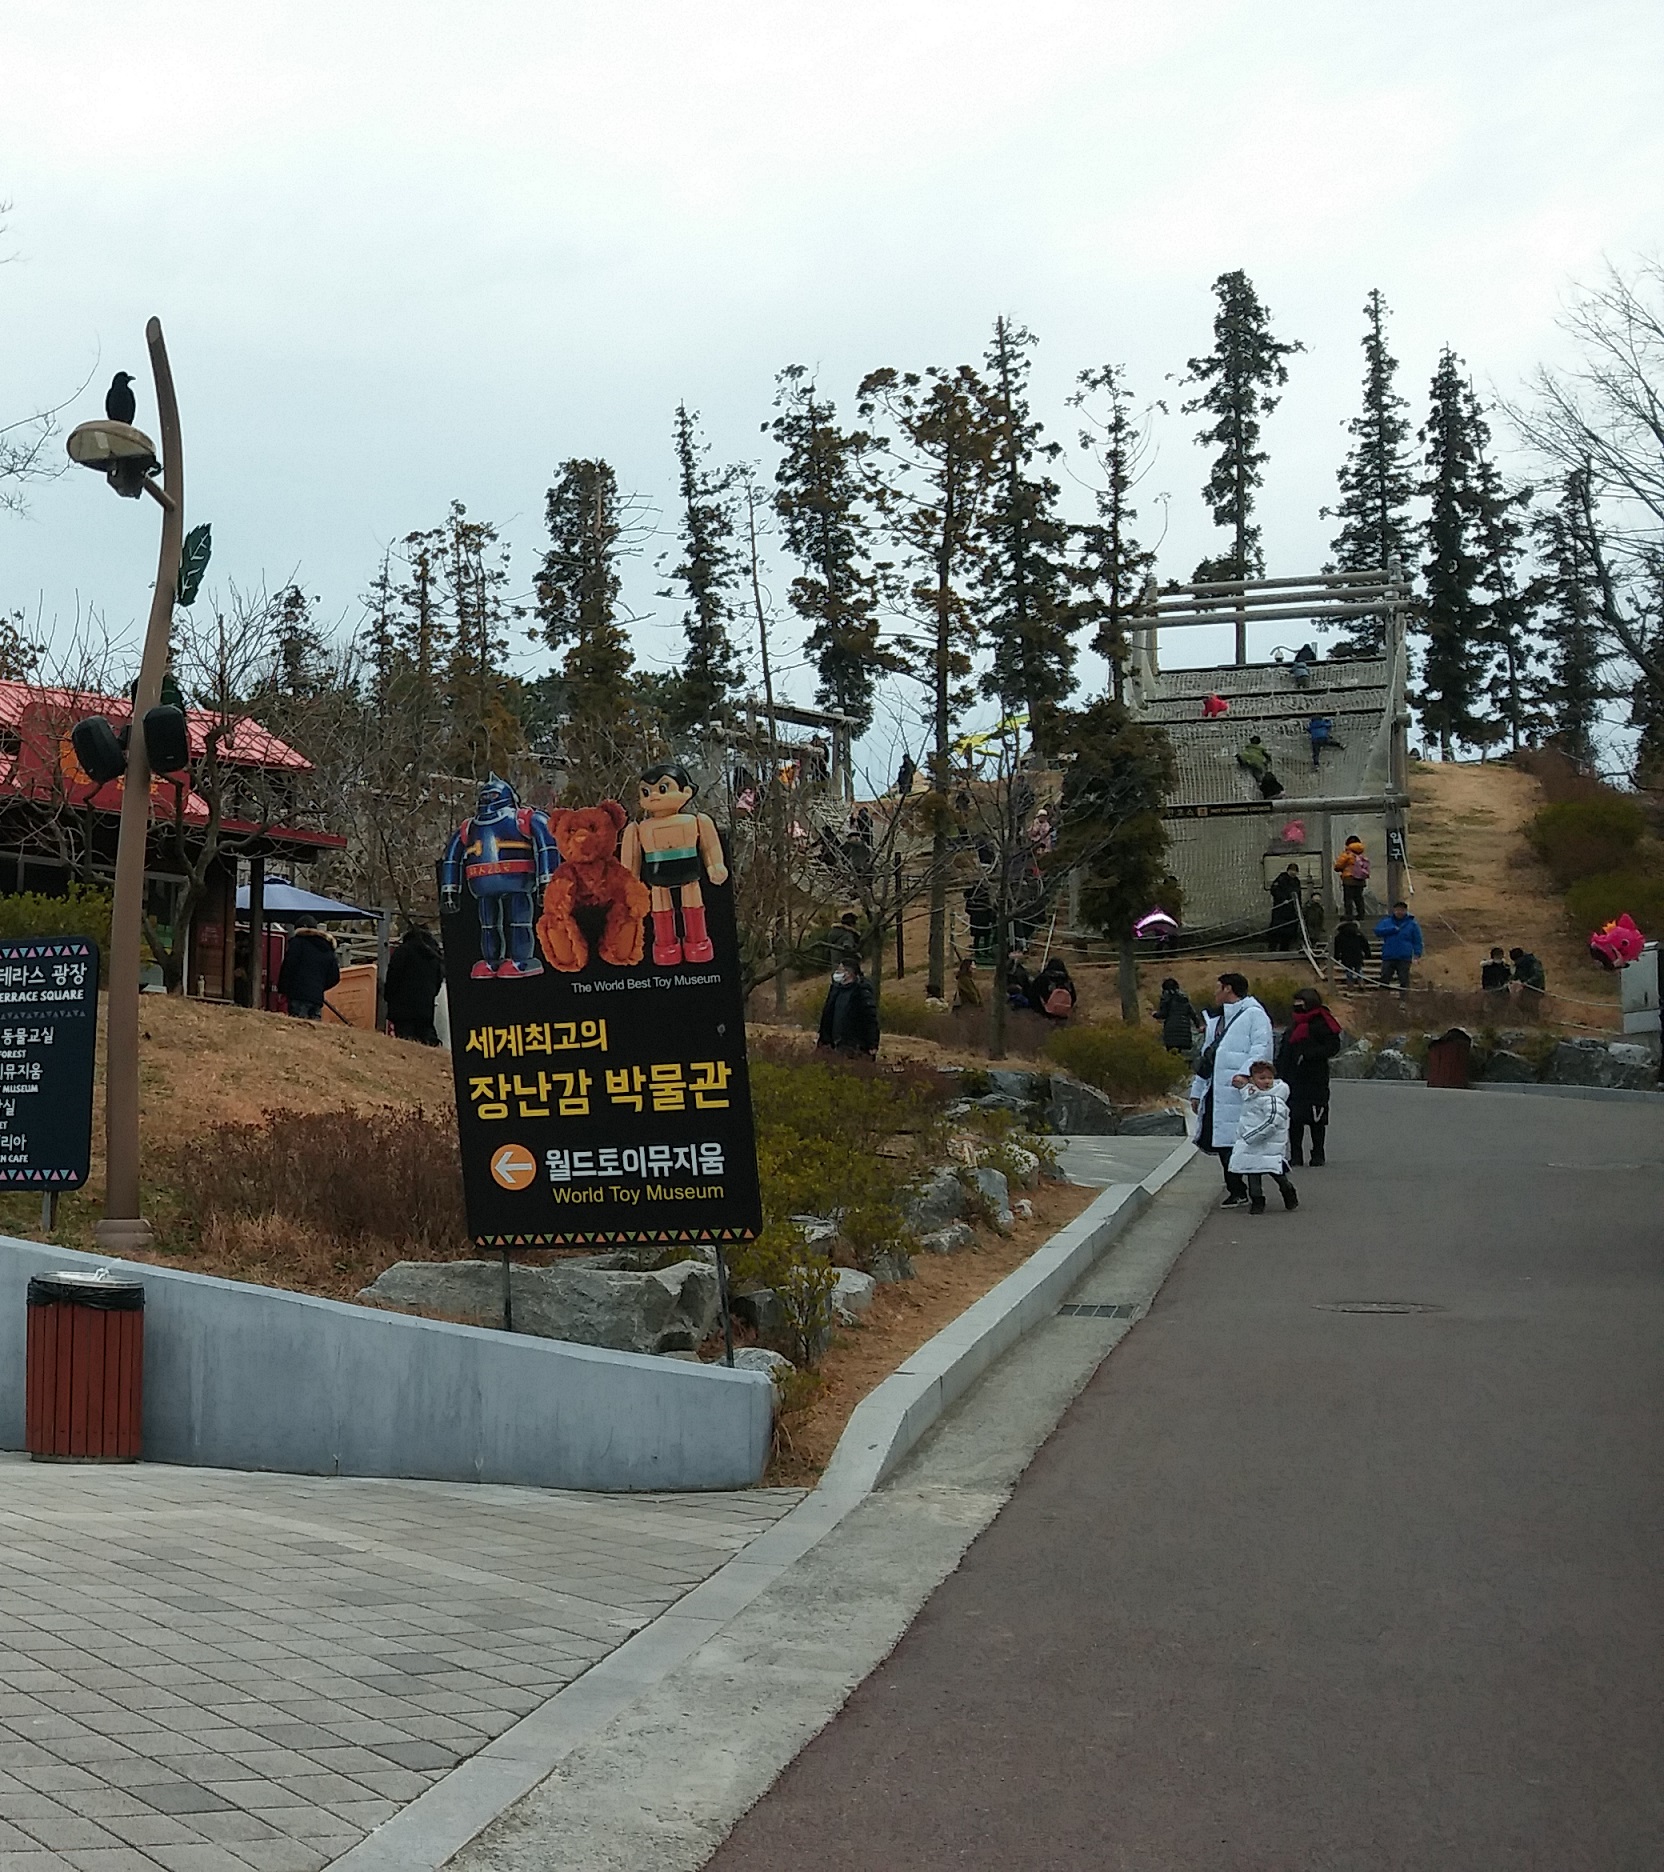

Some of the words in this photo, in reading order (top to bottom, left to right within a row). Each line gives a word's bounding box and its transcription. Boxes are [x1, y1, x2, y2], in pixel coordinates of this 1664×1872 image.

[52, 963, 87, 986] 광장
[571, 981, 593, 994] The
[594, 979, 625, 993] World
[627, 976, 651, 990] Best
[653, 975, 673, 991] Toy
[674, 972, 721, 988] Museum
[41, 990, 84, 1001] SQUARE
[1, 1026, 54, 1045] 동물교실
[465, 1018, 609, 1059] 세계최고의
[2, 1084, 39, 1093] MUSEUM
[468, 1070, 592, 1120] 장난감
[605, 1060, 732, 1114] 박물관
[8, 1154, 29, 1163] CAFE
[544, 1142, 726, 1182] 월드토이뮤지움
[552, 1186, 605, 1206] World
[609, 1185, 641, 1206] Toy
[646, 1183, 725, 1202] Museum
